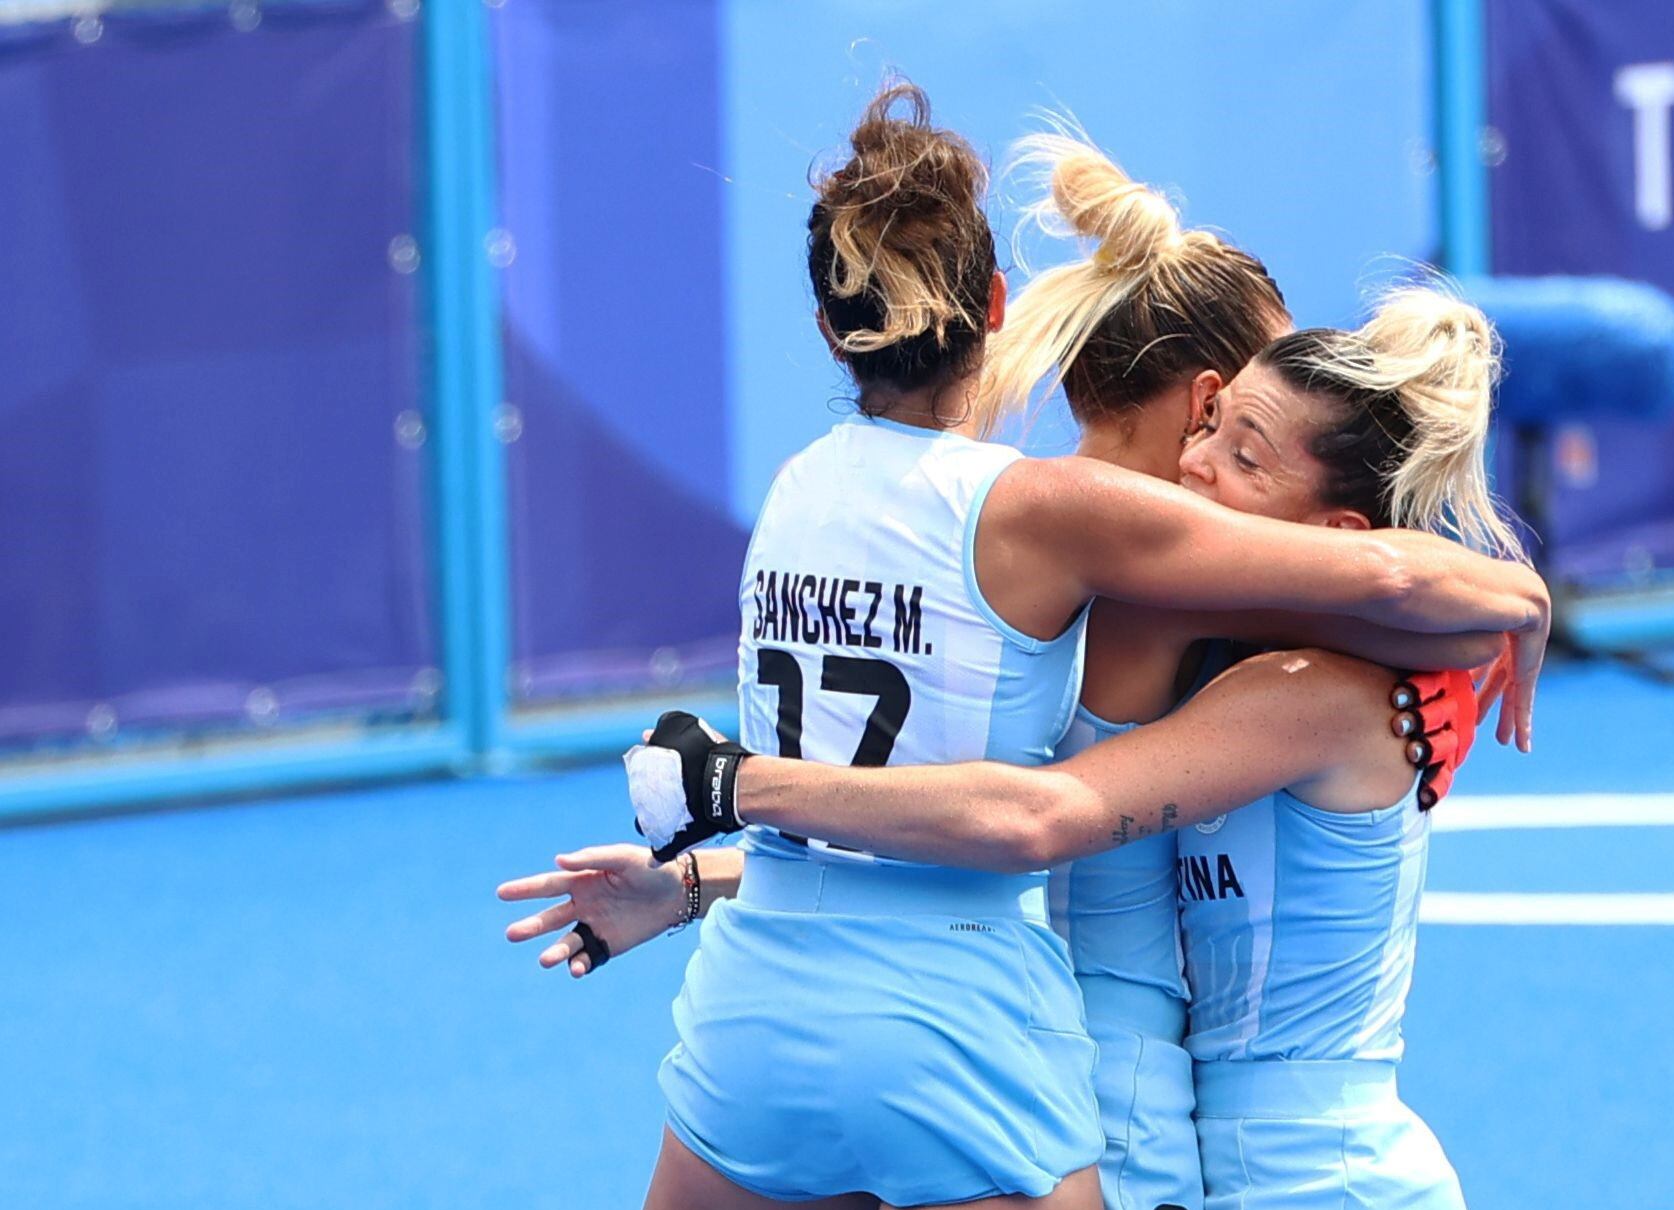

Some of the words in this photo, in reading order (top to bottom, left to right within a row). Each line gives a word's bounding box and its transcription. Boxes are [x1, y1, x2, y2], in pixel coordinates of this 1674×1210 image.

[753, 569, 883, 648] SANCHEZ
[893, 584, 932, 655] M.
[757, 648, 911, 852] 17
